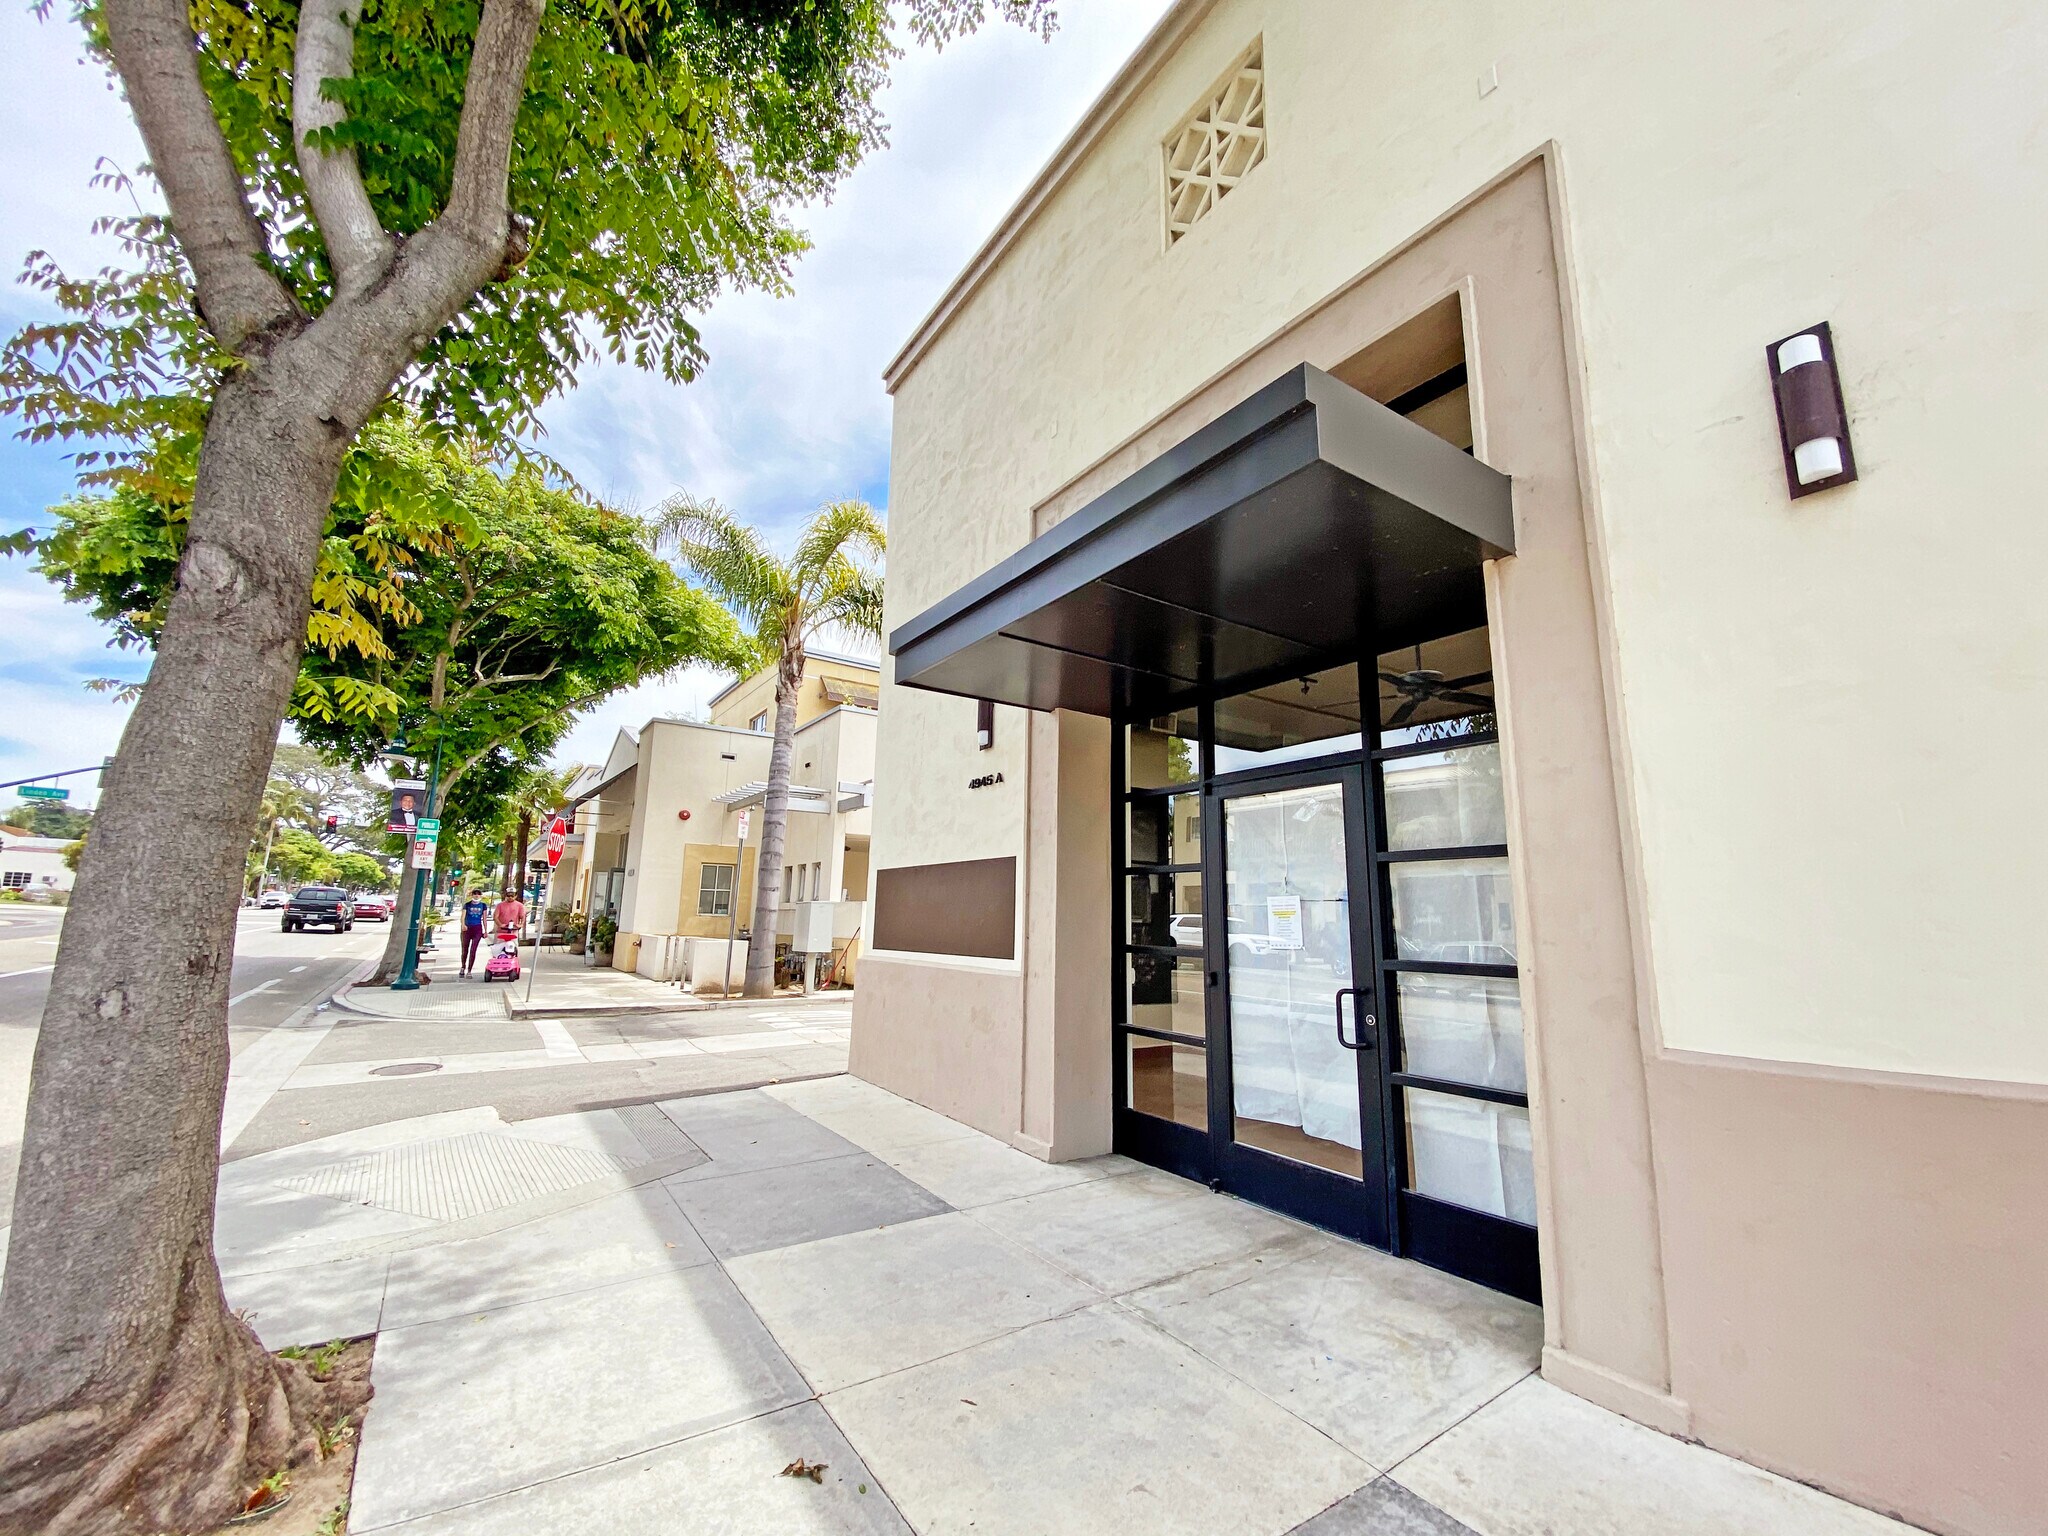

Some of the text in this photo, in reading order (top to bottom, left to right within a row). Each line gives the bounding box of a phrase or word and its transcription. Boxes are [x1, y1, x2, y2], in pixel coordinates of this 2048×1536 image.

[968, 772, 1004, 789] 4945 A
[549, 832, 565, 852] STOP
